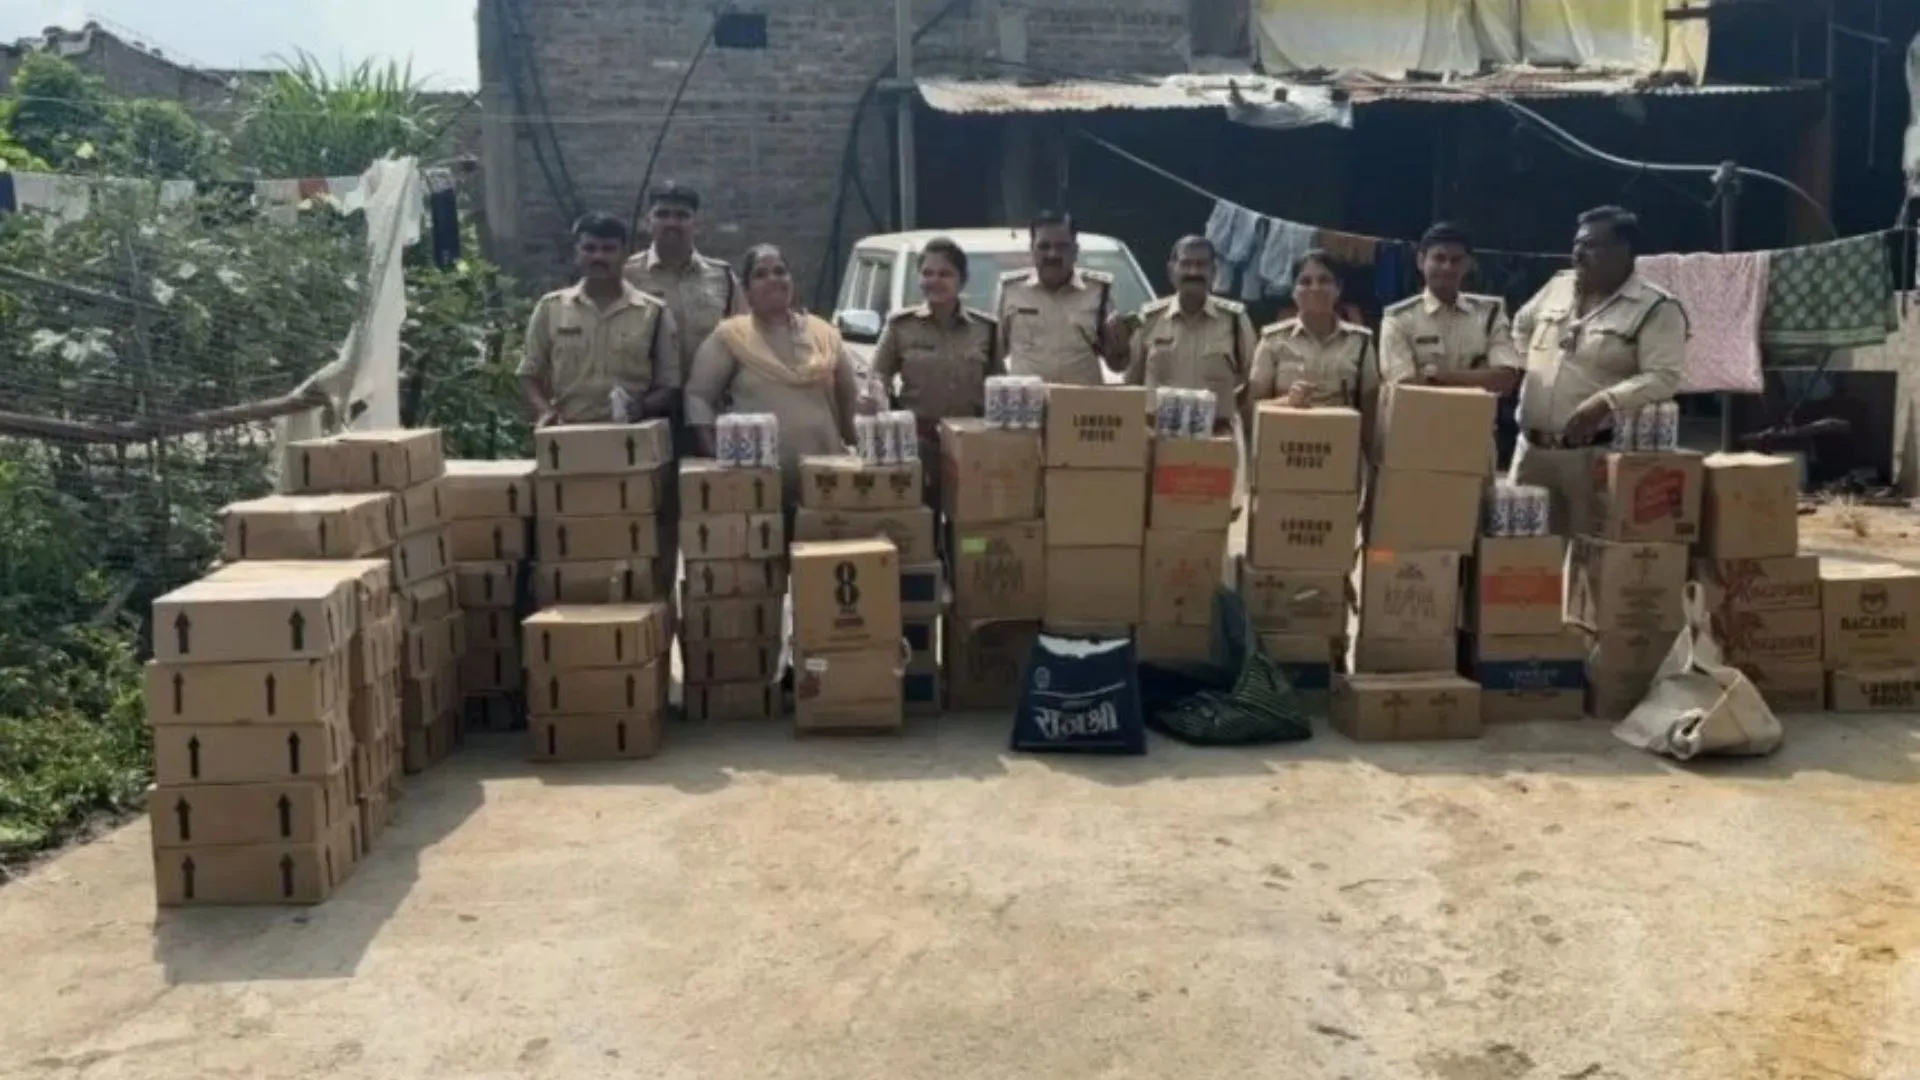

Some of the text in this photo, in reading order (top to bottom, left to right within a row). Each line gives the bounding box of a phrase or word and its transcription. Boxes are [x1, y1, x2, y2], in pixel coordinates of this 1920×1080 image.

[1072, 413, 1123, 428] LONDON
[1280, 440, 1332, 455] LONDON
[1280, 517, 1333, 533] LONDON
